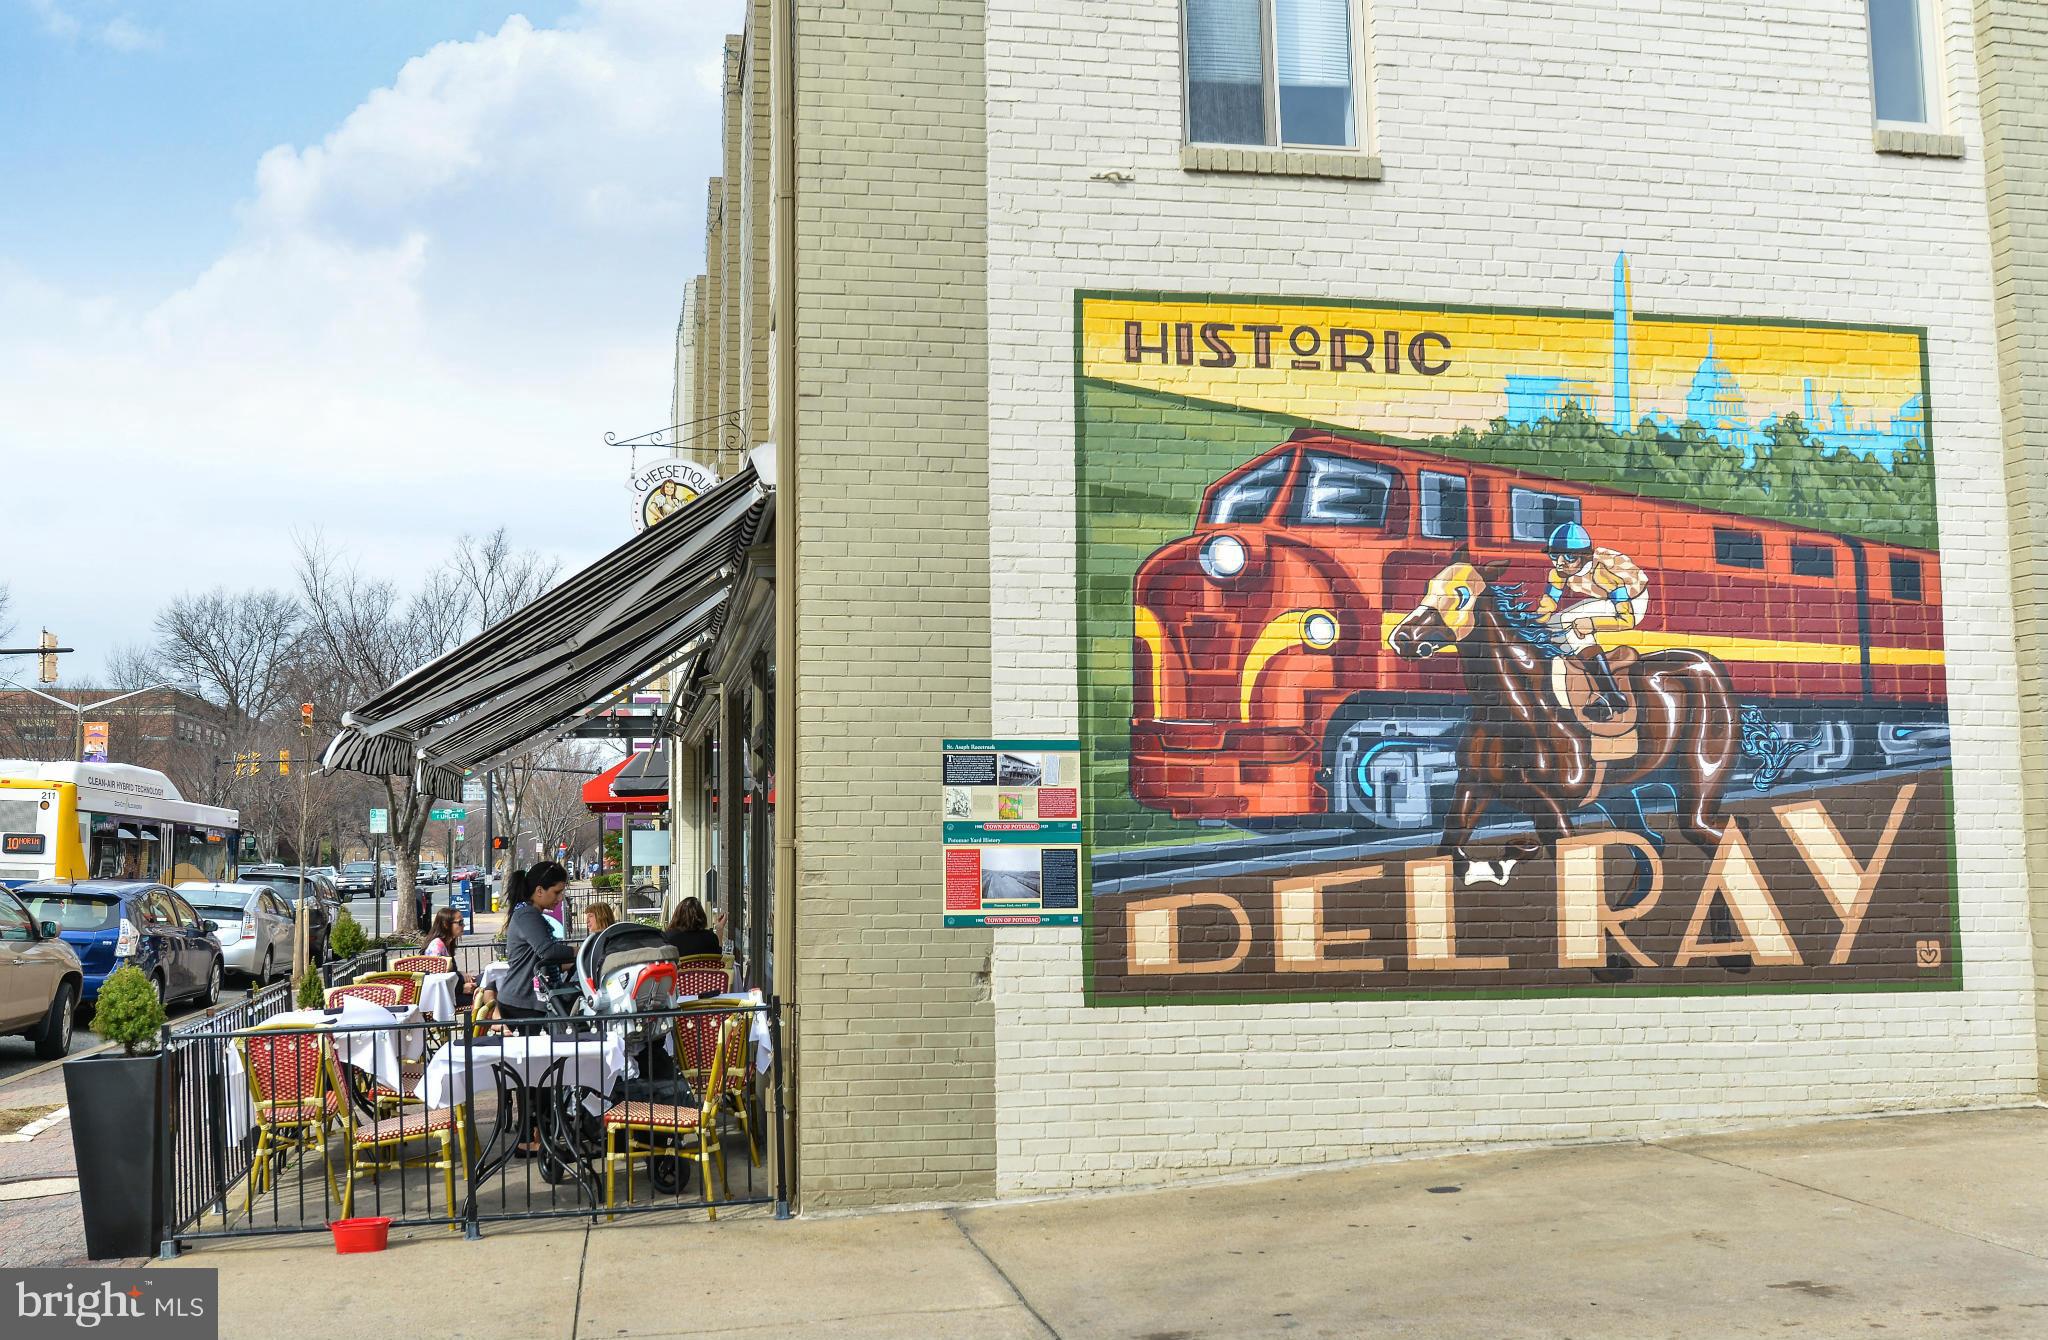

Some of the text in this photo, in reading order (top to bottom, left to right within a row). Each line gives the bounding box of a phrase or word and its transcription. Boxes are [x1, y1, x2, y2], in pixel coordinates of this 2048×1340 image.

[1124, 320, 1452, 375] HISTORIC
[41, 792, 56, 800] 211
[87, 776, 164, 796] CLEAN-AIR HYBRID TECHNOLOGY
[7, 837, 40, 850] 10 NORTH
[1125, 783, 1918, 976] DEL RAY
